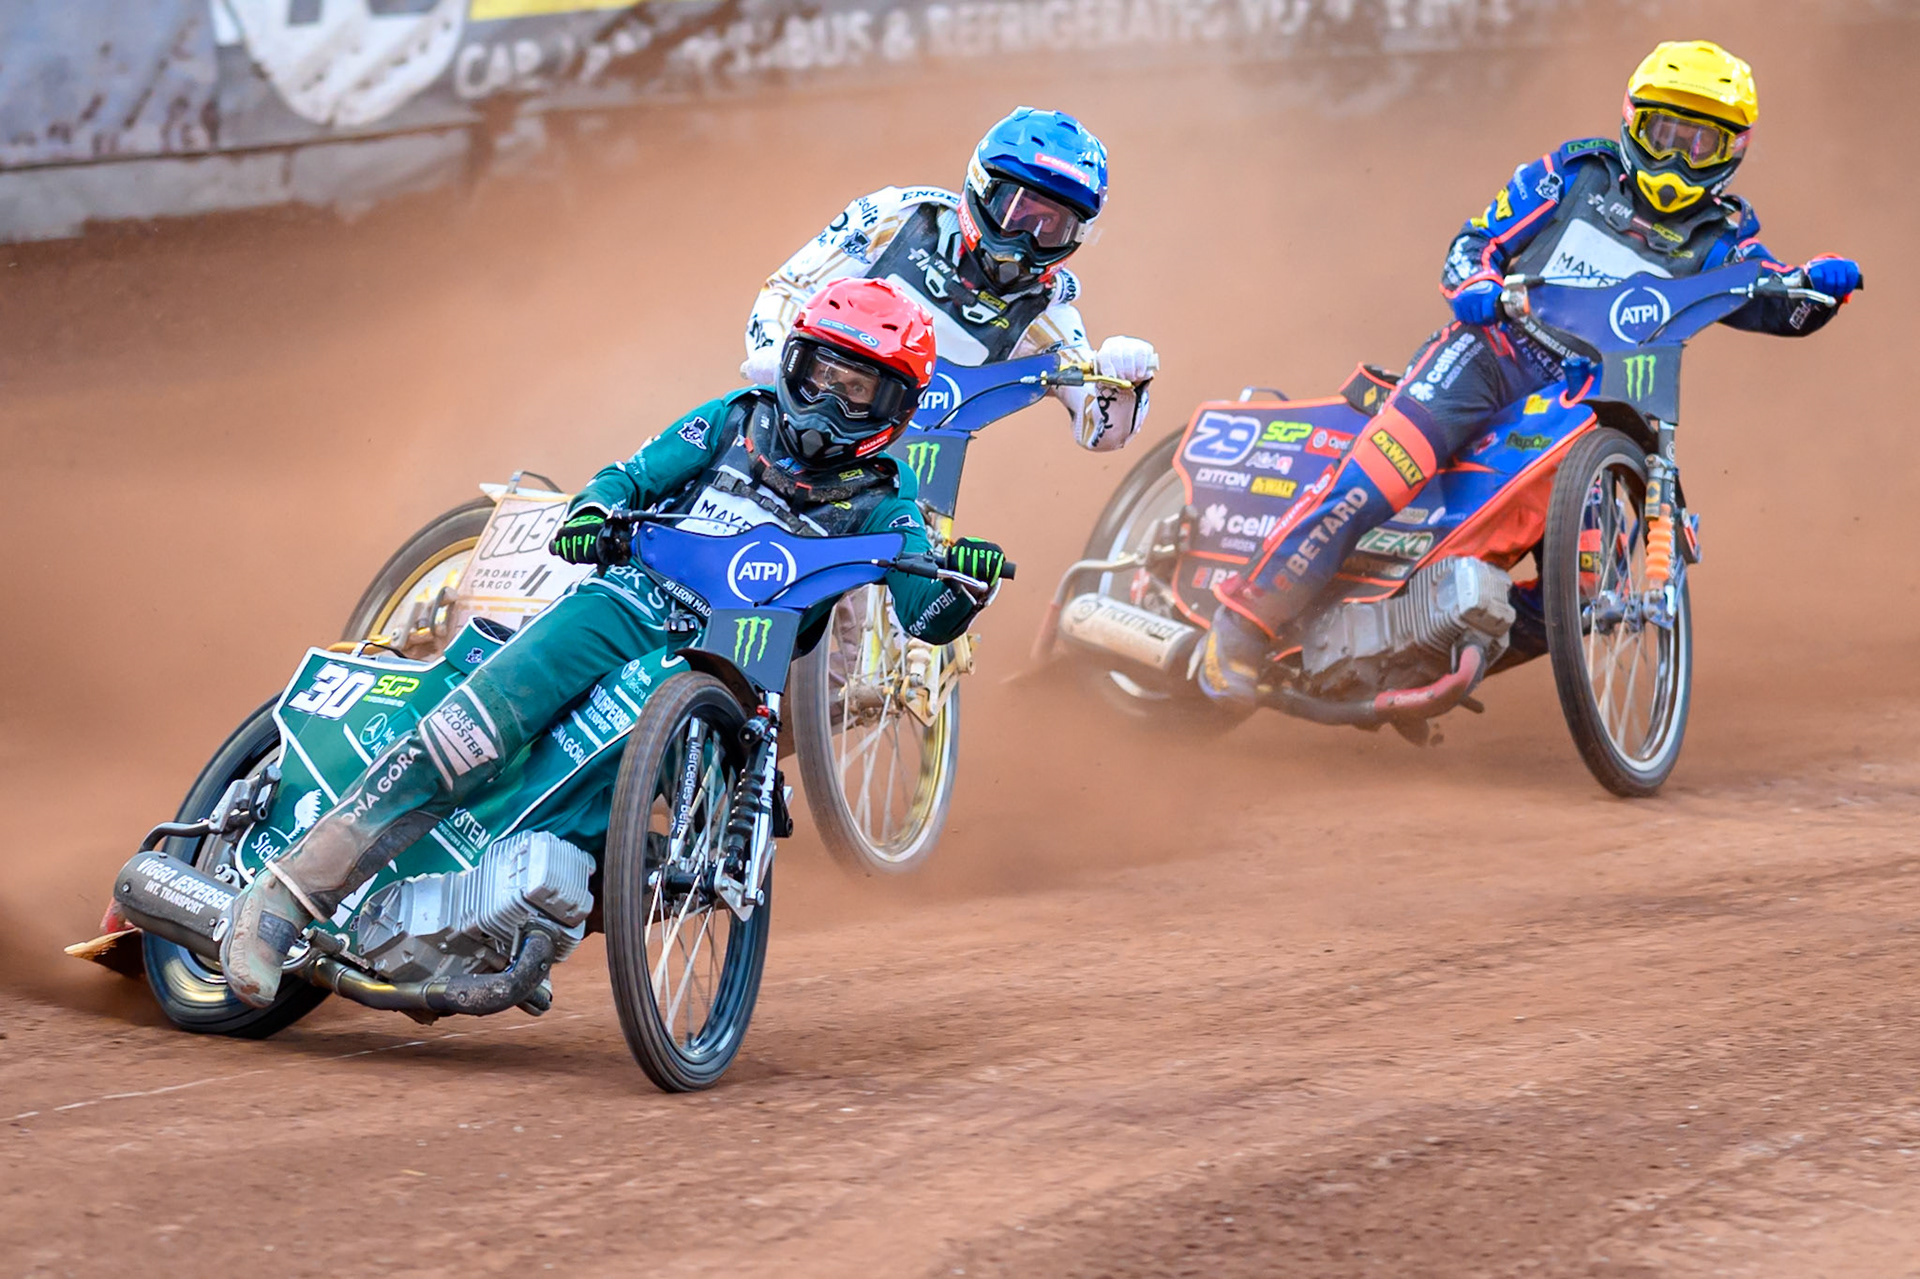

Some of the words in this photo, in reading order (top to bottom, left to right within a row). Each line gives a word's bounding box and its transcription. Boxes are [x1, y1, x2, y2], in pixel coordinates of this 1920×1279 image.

[1619, 303, 1659, 325] ATPI
[1184, 411, 1261, 466] 29
[1262, 420, 1313, 442] SGP
[1372, 430, 1423, 488] DEWALT
[1286, 486, 1368, 577] BETARD
[470, 580, 512, 590] CARGO
[475, 567, 528, 579] PROMET
[737, 561, 783, 582] ATPI
[663, 580, 675, 592] 30
[672, 586, 695, 607] LEON
[287, 660, 377, 721] 30
[369, 674, 421, 698] SGP
[440, 708, 484, 759] KLOSTER
[445, 702, 476, 730] LARS
[376, 745, 423, 793] GÓRA
[676, 741, 700, 835] Mercedes-Benz
[136, 857, 171, 887] VIGGO
[170, 868, 234, 911] JESPERSEN
[144, 880, 159, 896] INT.
[159, 884, 205, 915] TRANSPORT
